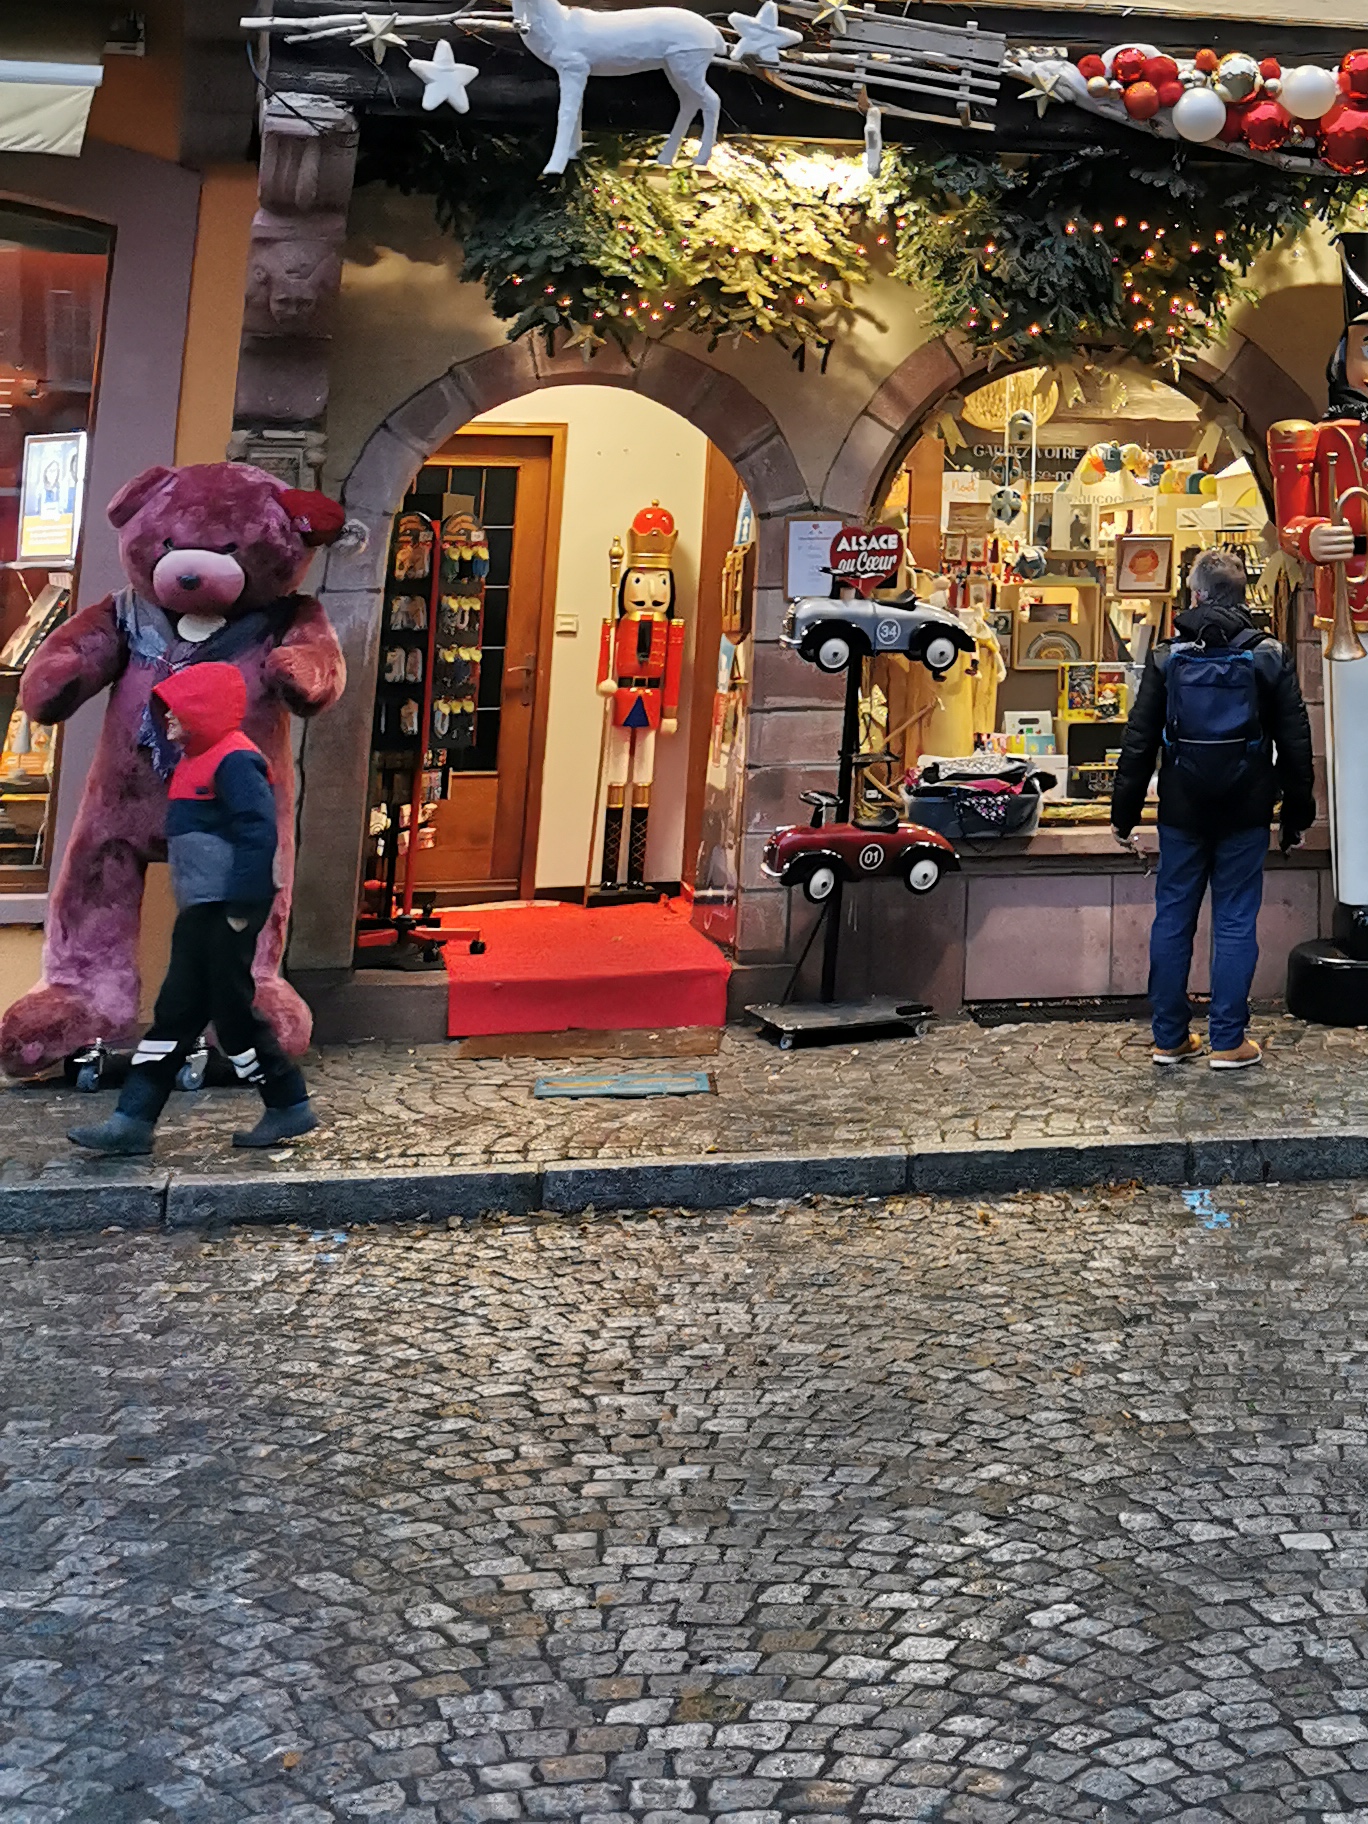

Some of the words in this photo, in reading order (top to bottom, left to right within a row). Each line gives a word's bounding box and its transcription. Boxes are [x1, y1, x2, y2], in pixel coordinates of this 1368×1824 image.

[836, 533, 899, 552] ALSACE
[838, 558, 856, 571] au
[856, 552, 898, 572] Cœur
[879, 624, 897, 638] 34
[864, 850, 879, 864] 01
